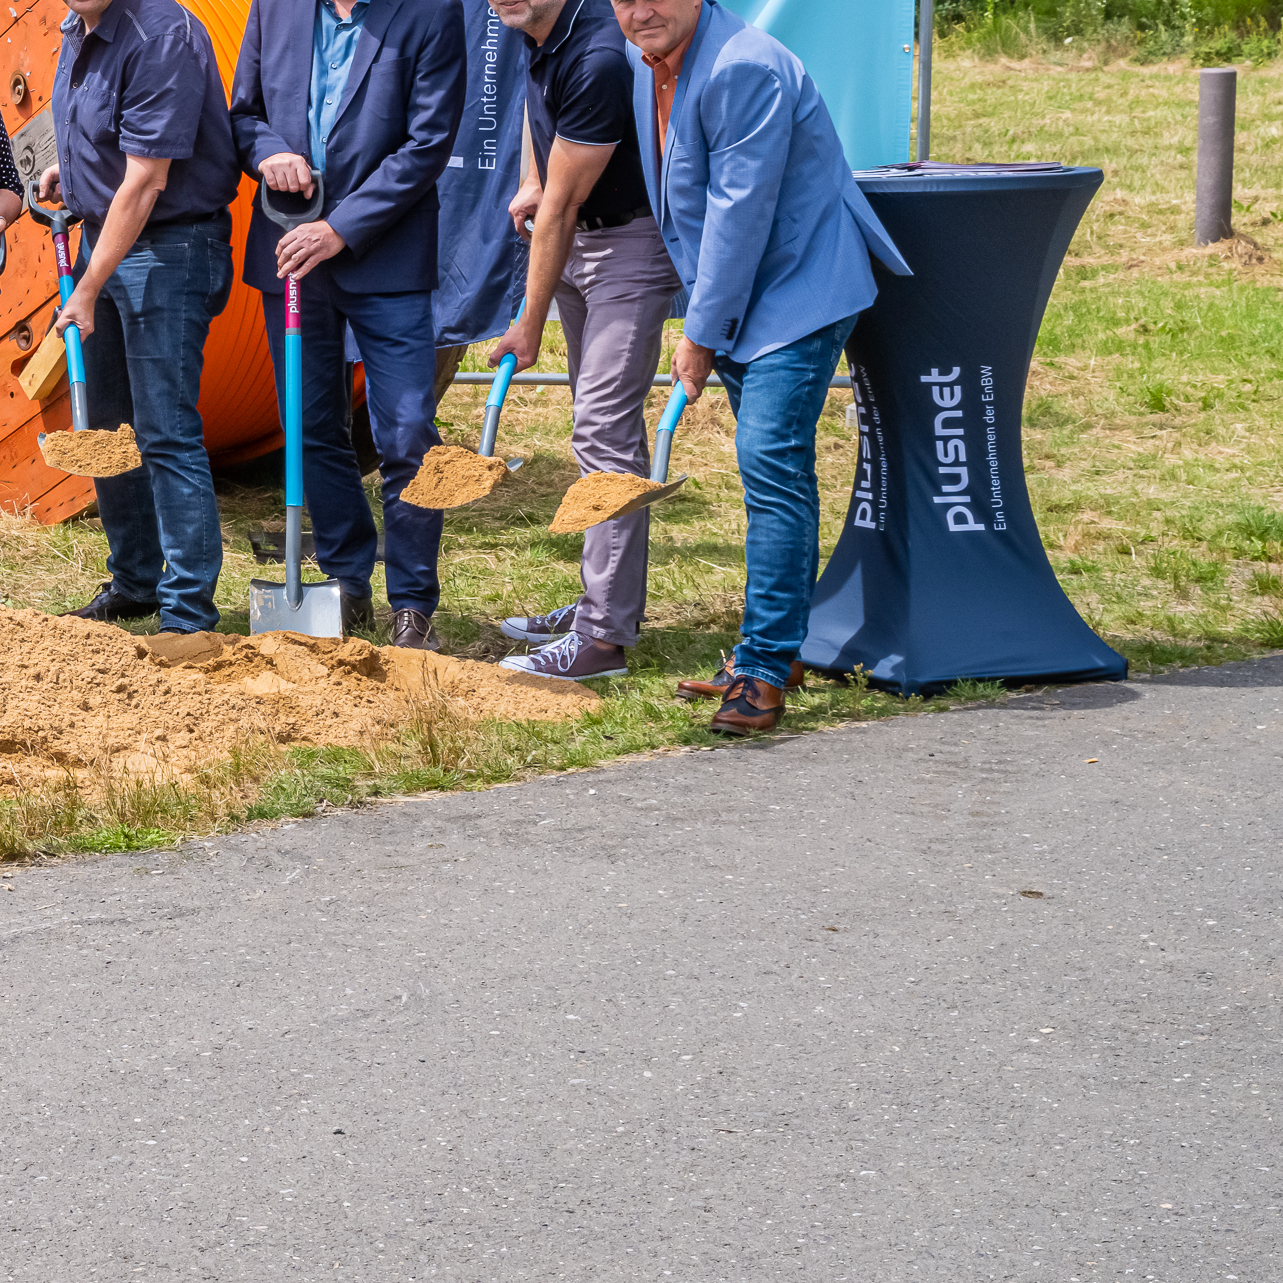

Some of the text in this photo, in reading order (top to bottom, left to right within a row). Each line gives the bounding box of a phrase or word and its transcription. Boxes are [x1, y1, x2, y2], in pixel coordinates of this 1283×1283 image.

[478, 6, 499, 170] Ein Unternehme
[55, 241, 69, 268] plusnet
[870, 404, 881, 424] der
[920, 366, 986, 532] plusnet
[980, 365, 1007, 531] Ein Unternehmen der EnBW
